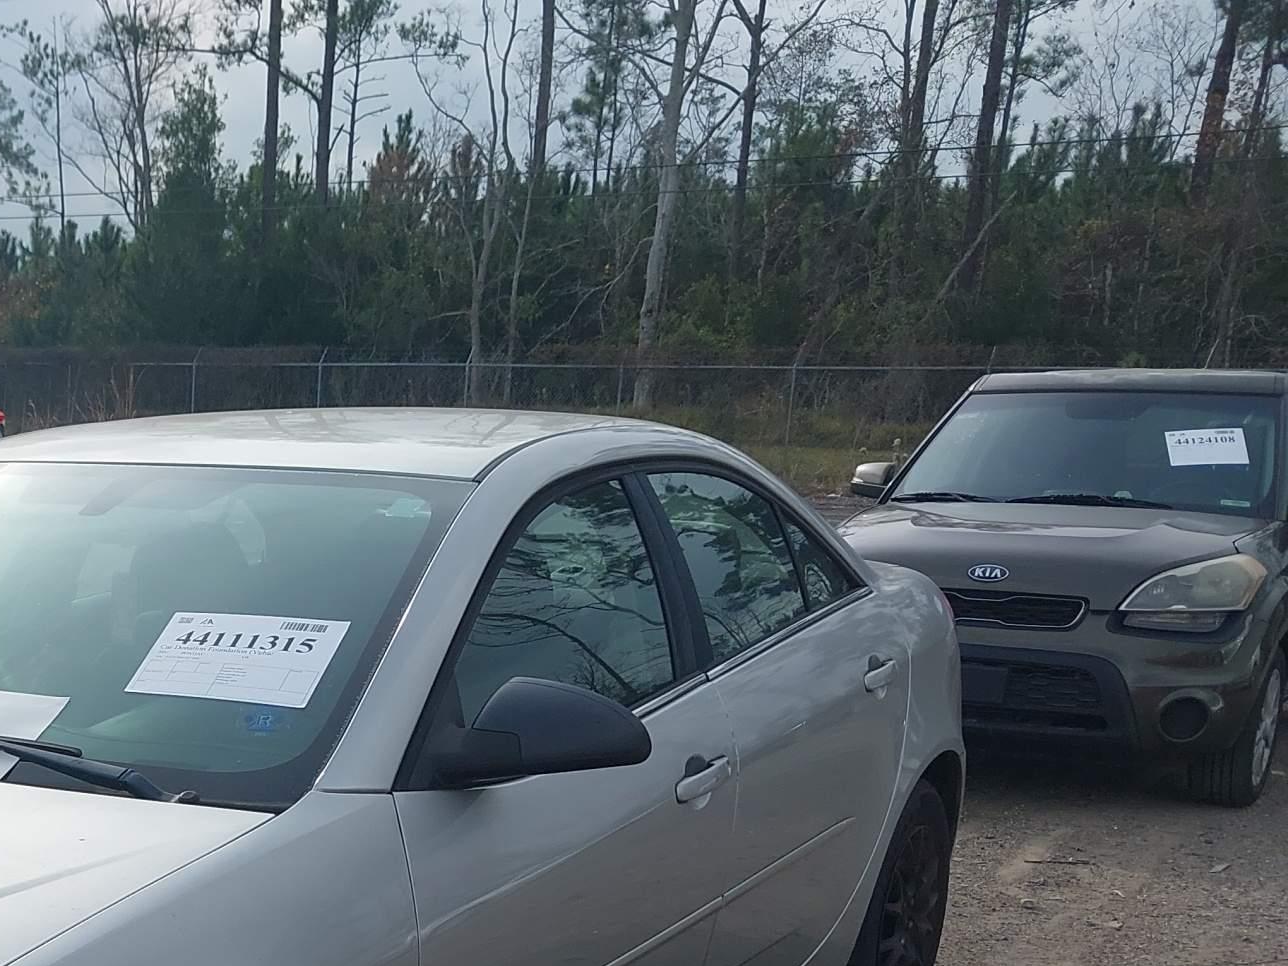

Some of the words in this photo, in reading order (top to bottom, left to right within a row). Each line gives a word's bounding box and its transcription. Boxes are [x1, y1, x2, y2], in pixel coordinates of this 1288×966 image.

[1174, 436, 1236, 445] 44124108
[974, 567, 1001, 578] KIA
[175, 630, 318, 654] 44111315
